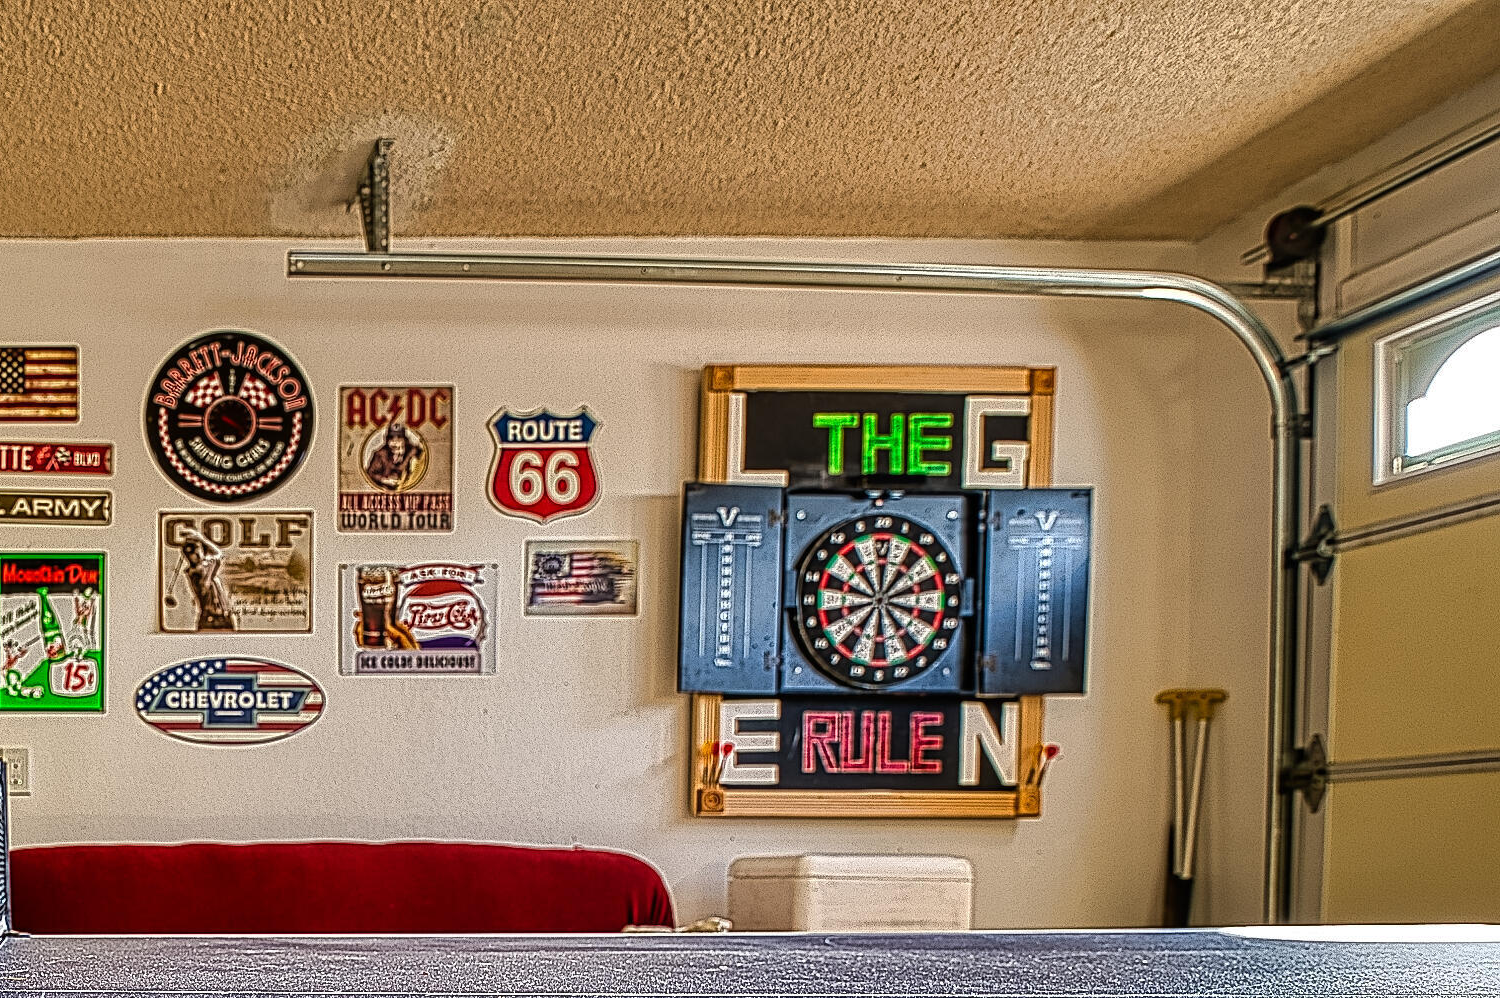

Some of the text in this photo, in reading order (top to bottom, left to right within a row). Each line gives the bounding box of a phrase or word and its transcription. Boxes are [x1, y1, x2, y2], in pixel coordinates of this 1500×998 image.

[153, 341, 308, 412] BARRETT-JACKSON
[507, 420, 584, 441] ROUTE
[813, 413, 954, 476] THE
[509, 450, 581, 505] 66
[10, 497, 102, 517] ARMY
[165, 518, 309, 548] GOLF
[341, 513, 450, 529] WORLD TOUR
[360, 655, 377, 669] ICE
[165, 691, 294, 710] CHEVROLET
[802, 710, 944, 774] RULE
